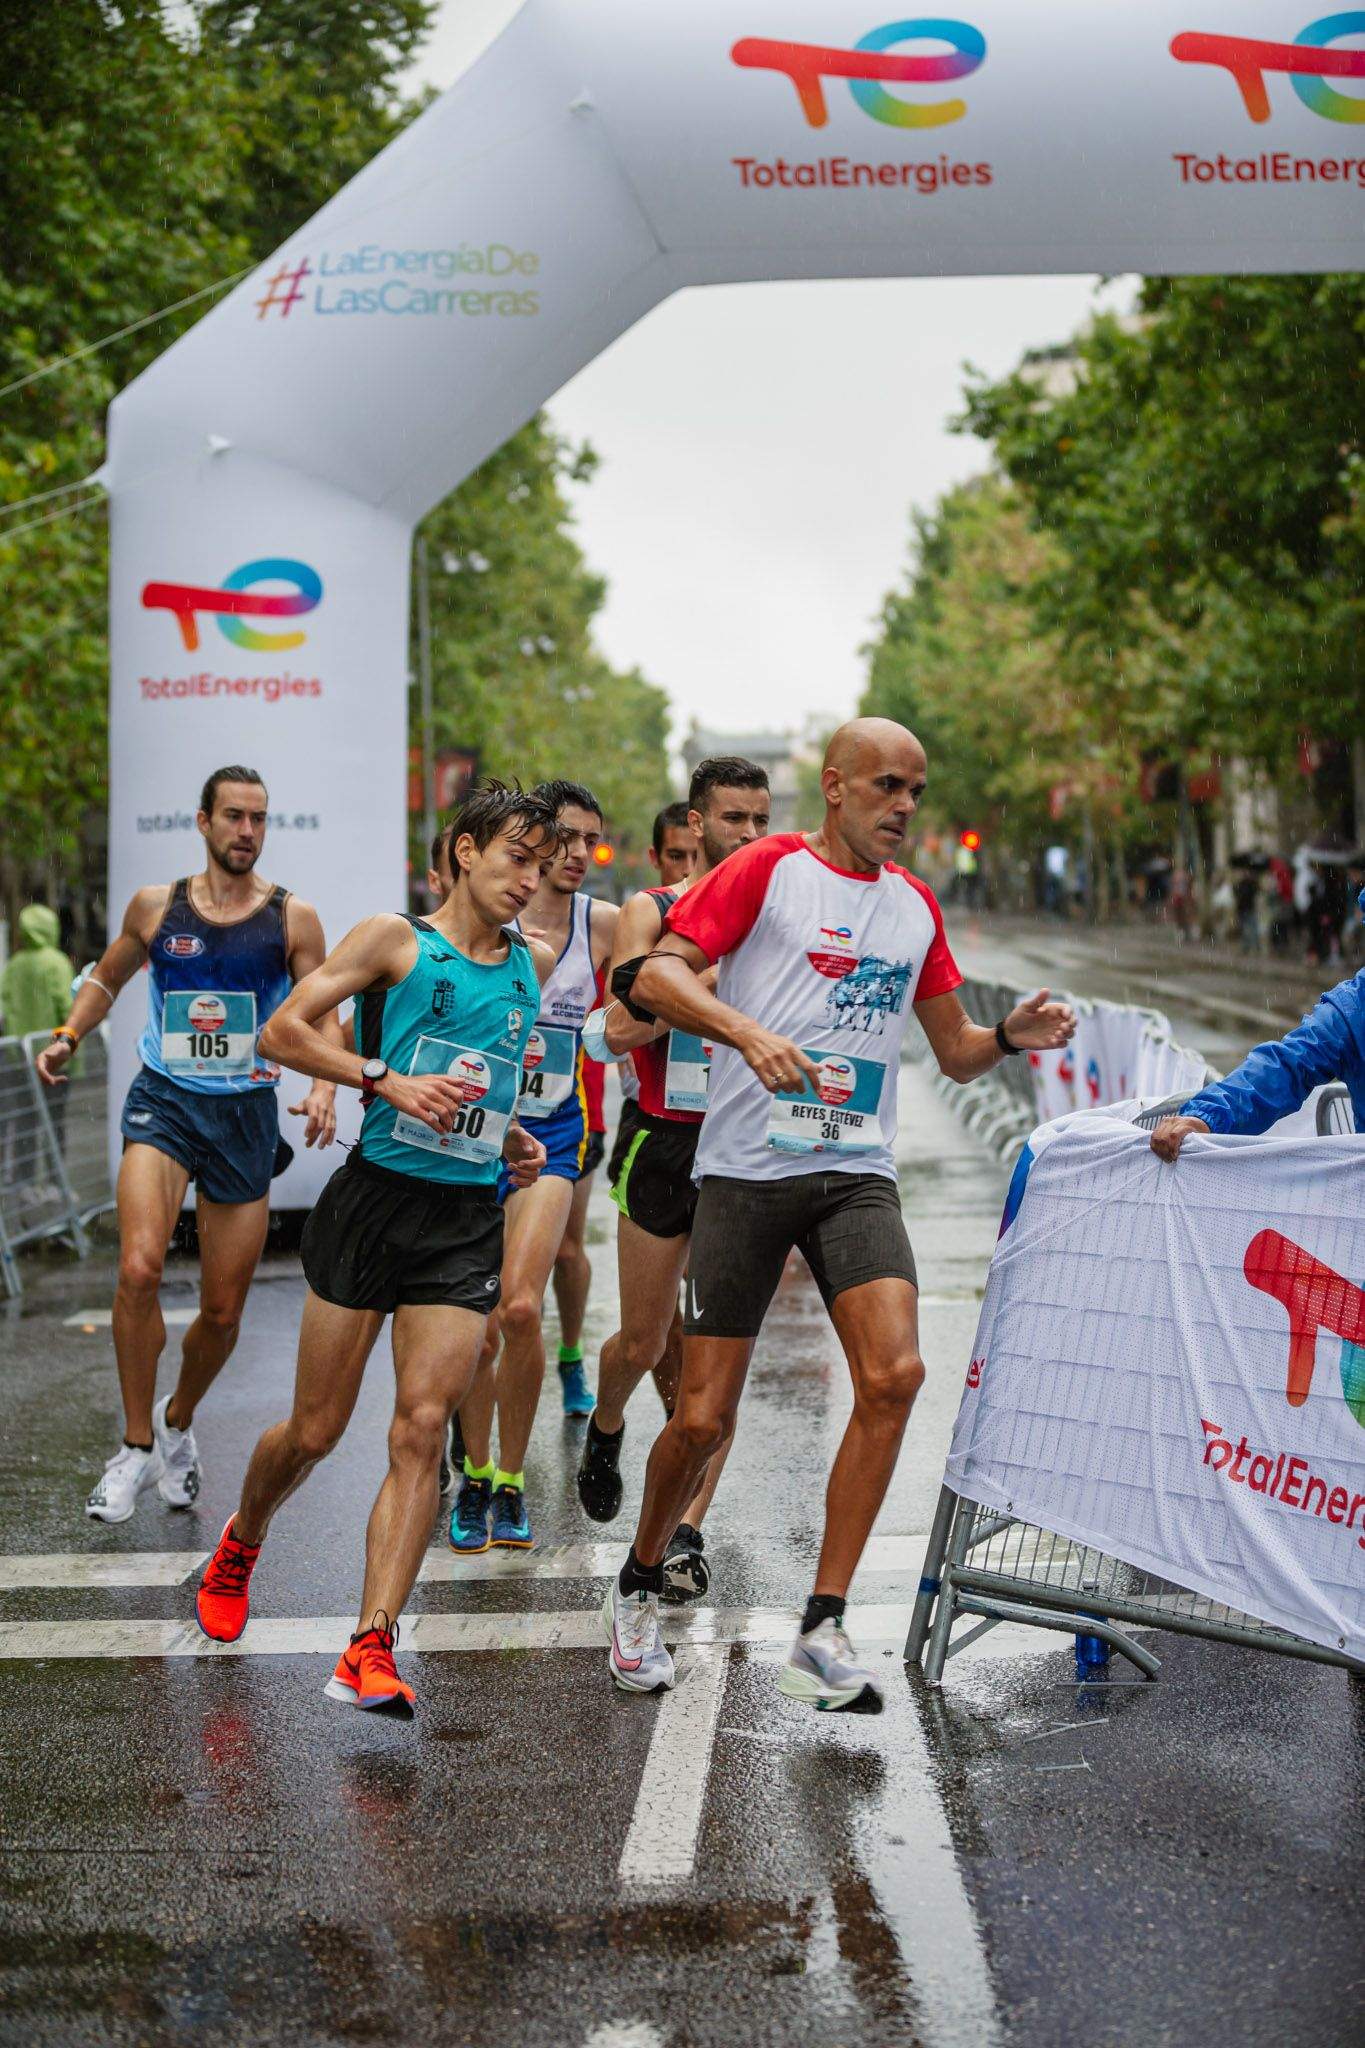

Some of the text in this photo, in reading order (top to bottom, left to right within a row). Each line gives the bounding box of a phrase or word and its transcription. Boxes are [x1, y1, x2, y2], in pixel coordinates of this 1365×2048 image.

[732, 154, 993, 195] TotalEnergies
[314, 279, 540, 317] LasCarreras
[139, 672, 322, 703] TotalEnergies
[187, 1034, 229, 1058] 105
[452, 1103, 486, 1139] 50
[792, 1104, 827, 1121] REYES
[821, 1122, 840, 1141] 36
